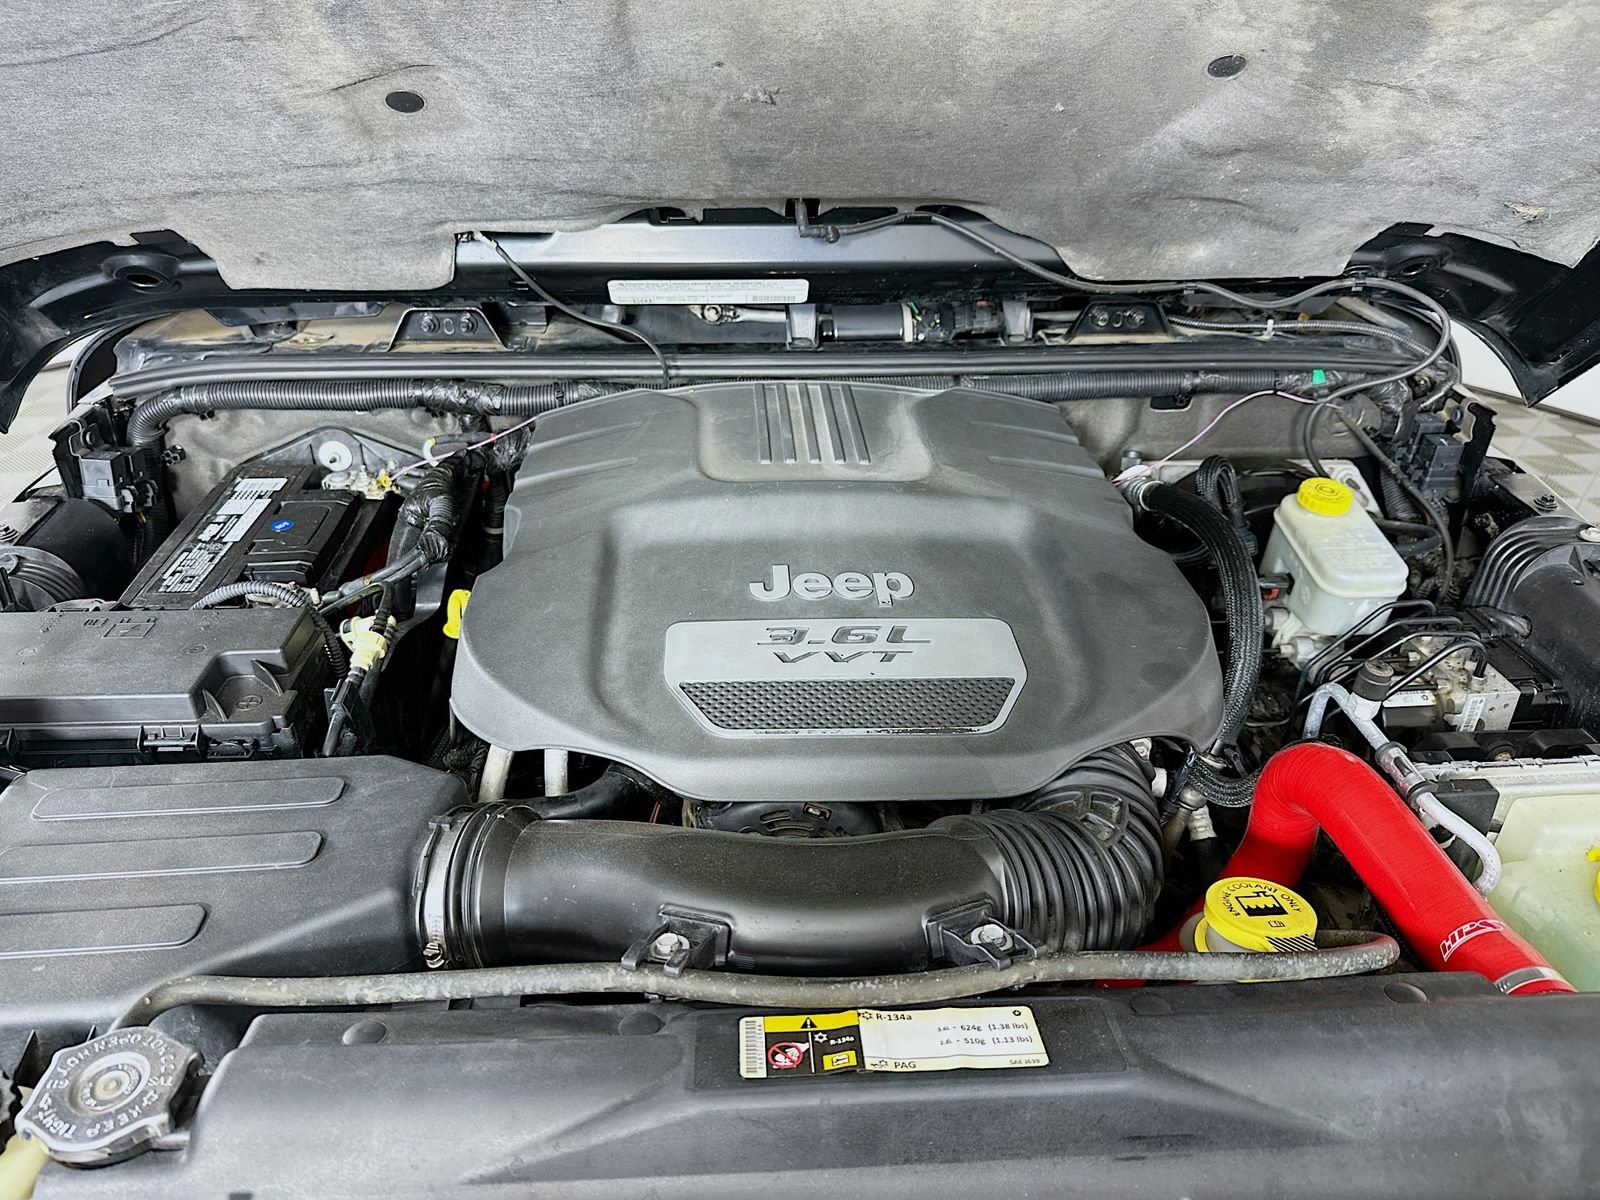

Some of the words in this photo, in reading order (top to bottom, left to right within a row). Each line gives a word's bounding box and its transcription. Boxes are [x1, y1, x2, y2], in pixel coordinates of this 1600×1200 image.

[749, 563, 915, 607] Jeep
[757, 625, 931, 646] 3.6L
[773, 650, 913, 664] VVT
[1227, 882, 1278, 894] COOLANT
[1281, 893, 1302, 913] ONLY
[1440, 919, 1506, 962] HPS
[876, 1012, 913, 1022] R-134a
[960, 1024, 982, 1032] 624g
[988, 1023, 1011, 1031] (1.38
[1012, 1022, 1029, 1030] lbs)
[963, 1037, 986, 1045] 510g
[992, 1036, 1015, 1045] (1.13
[1016, 1035, 1033, 1043] lbs)
[894, 1061, 917, 1069] PAG
